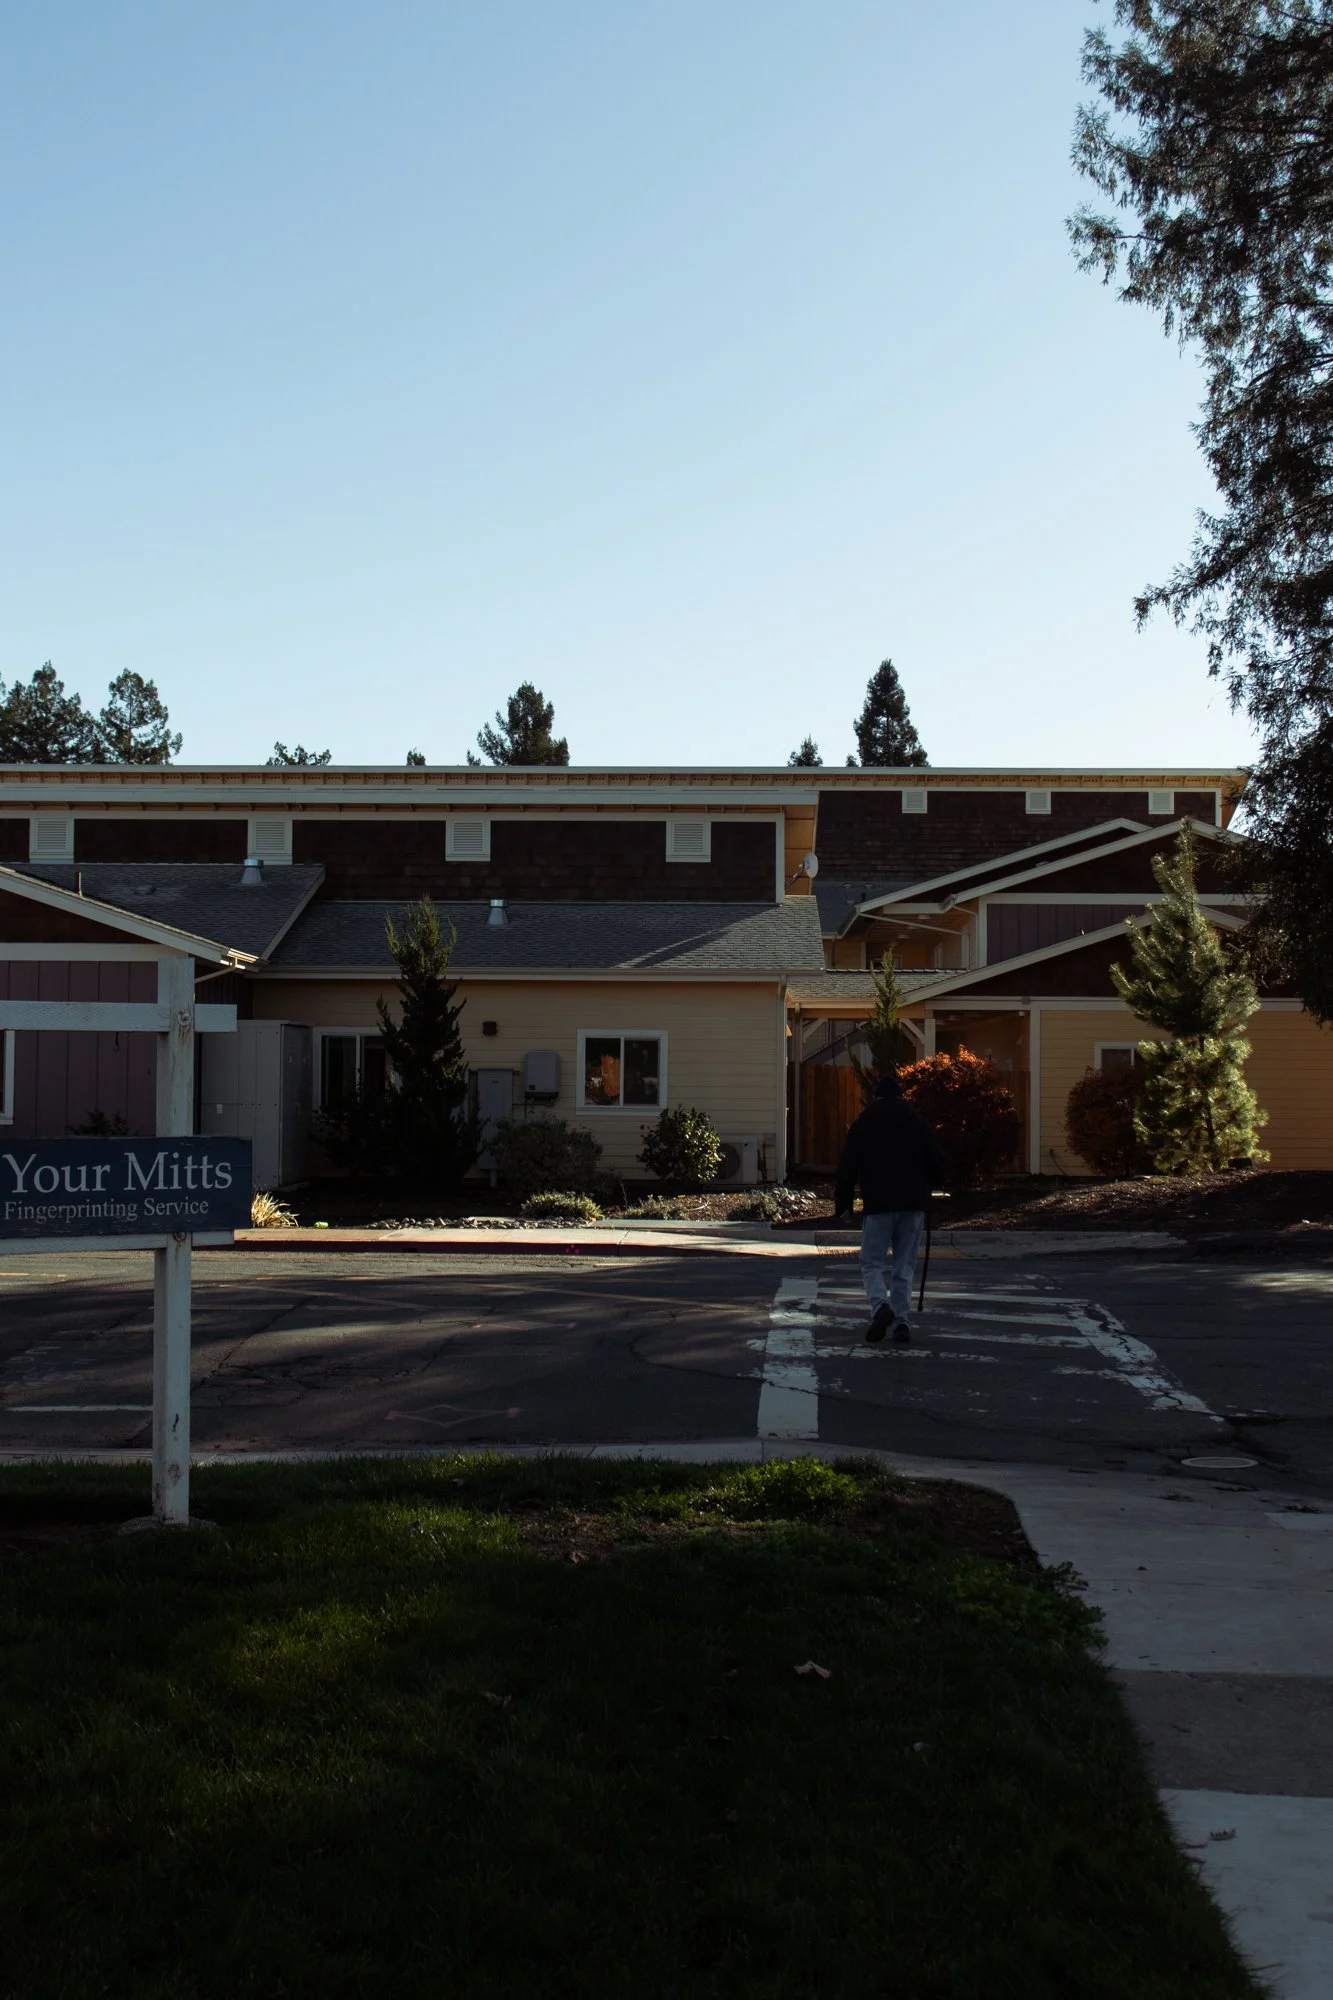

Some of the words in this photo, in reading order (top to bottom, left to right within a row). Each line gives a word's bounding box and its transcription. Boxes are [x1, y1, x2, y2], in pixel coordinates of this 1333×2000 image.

[2, 1153, 110, 1194] Your
[123, 1152, 233, 1191] Mitts
[4, 1198, 138, 1224] Fingerprinting
[144, 1197, 209, 1217] Service
